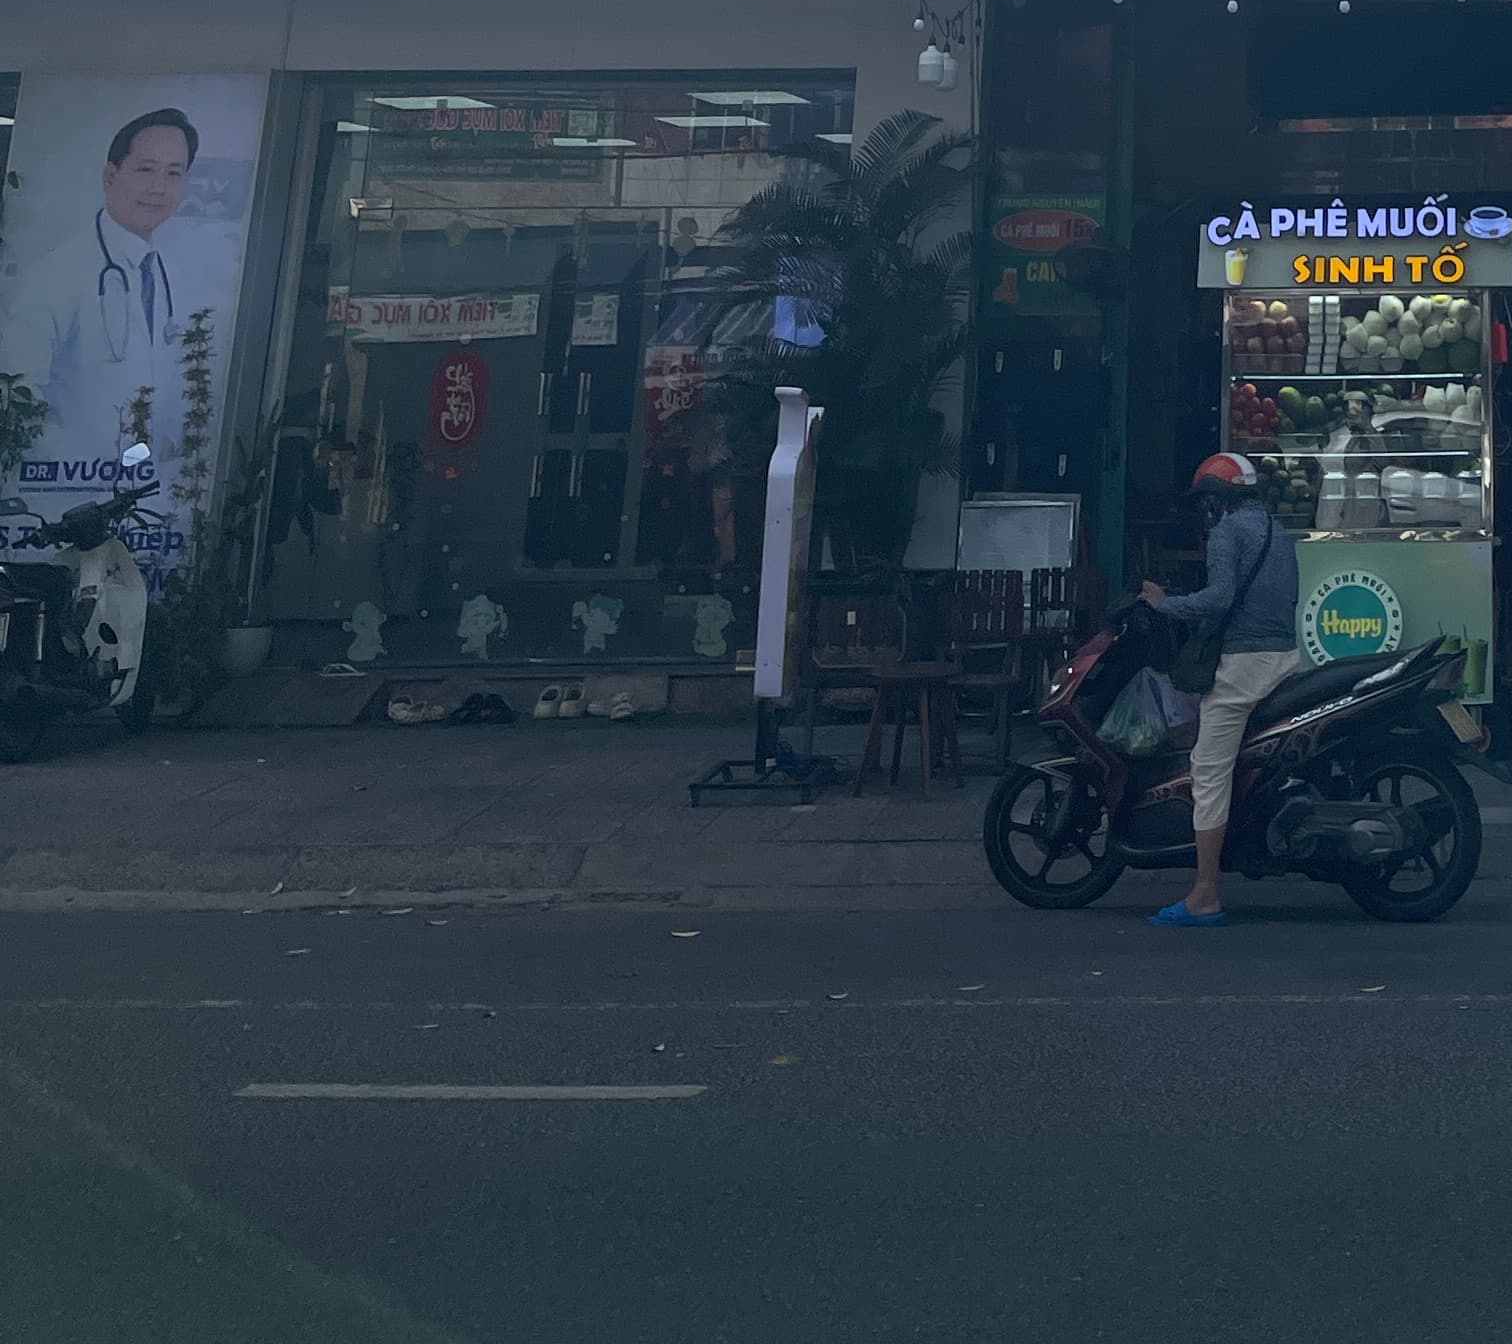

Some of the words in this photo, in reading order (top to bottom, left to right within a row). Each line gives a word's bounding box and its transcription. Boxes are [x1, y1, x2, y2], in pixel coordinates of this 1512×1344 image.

[1207, 201, 1260, 247] CÀ
[1269, 198, 1348, 238] PHÊ
[1357, 193, 1457, 238] MUỐI
[1293, 255, 1395, 284] SINH
[1406, 242, 1468, 284] TỐ
[26, 464, 52, 479] DR.
[1320, 608, 1382, 639] Happy
